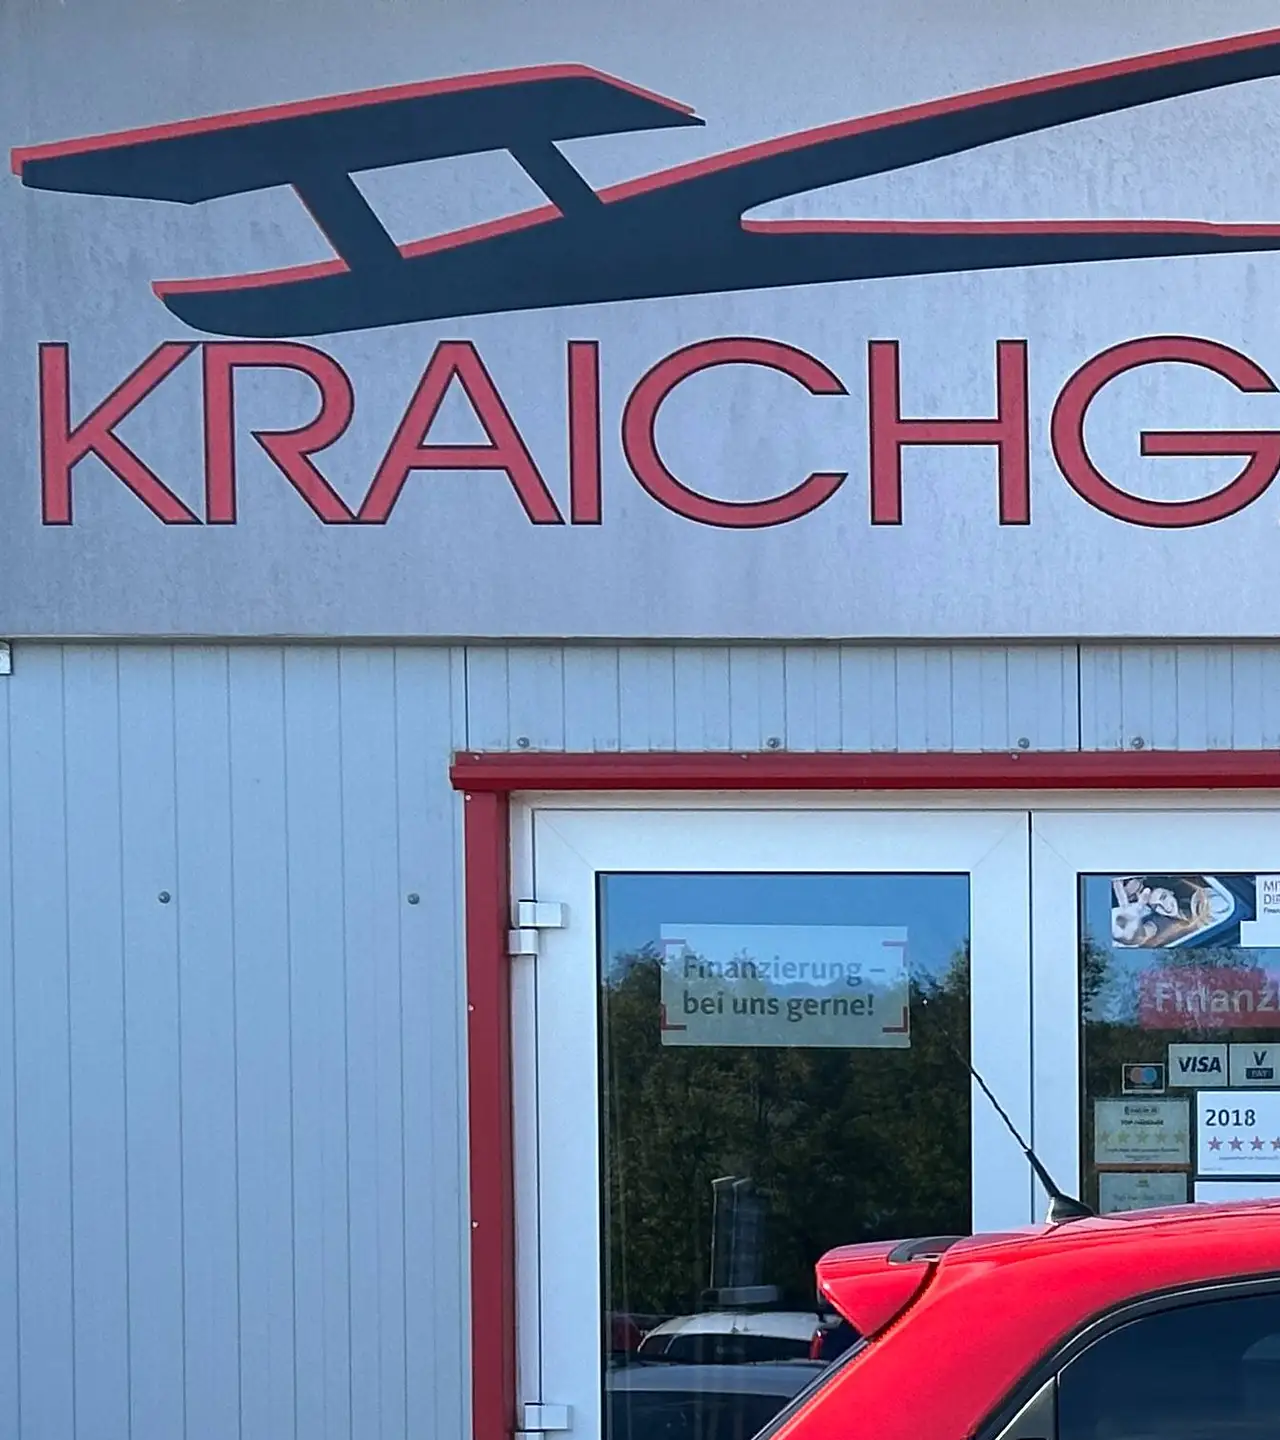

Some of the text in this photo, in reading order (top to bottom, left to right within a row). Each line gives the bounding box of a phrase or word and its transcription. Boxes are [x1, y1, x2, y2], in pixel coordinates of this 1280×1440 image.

[683, 954, 862, 988] Finanzierung
[683, 990, 875, 1023] bei uns gerne!
[1178, 1055, 1223, 1074] VISA
[1252, 1050, 1268, 1067] V
[1205, 1109, 1256, 1127] 2018
